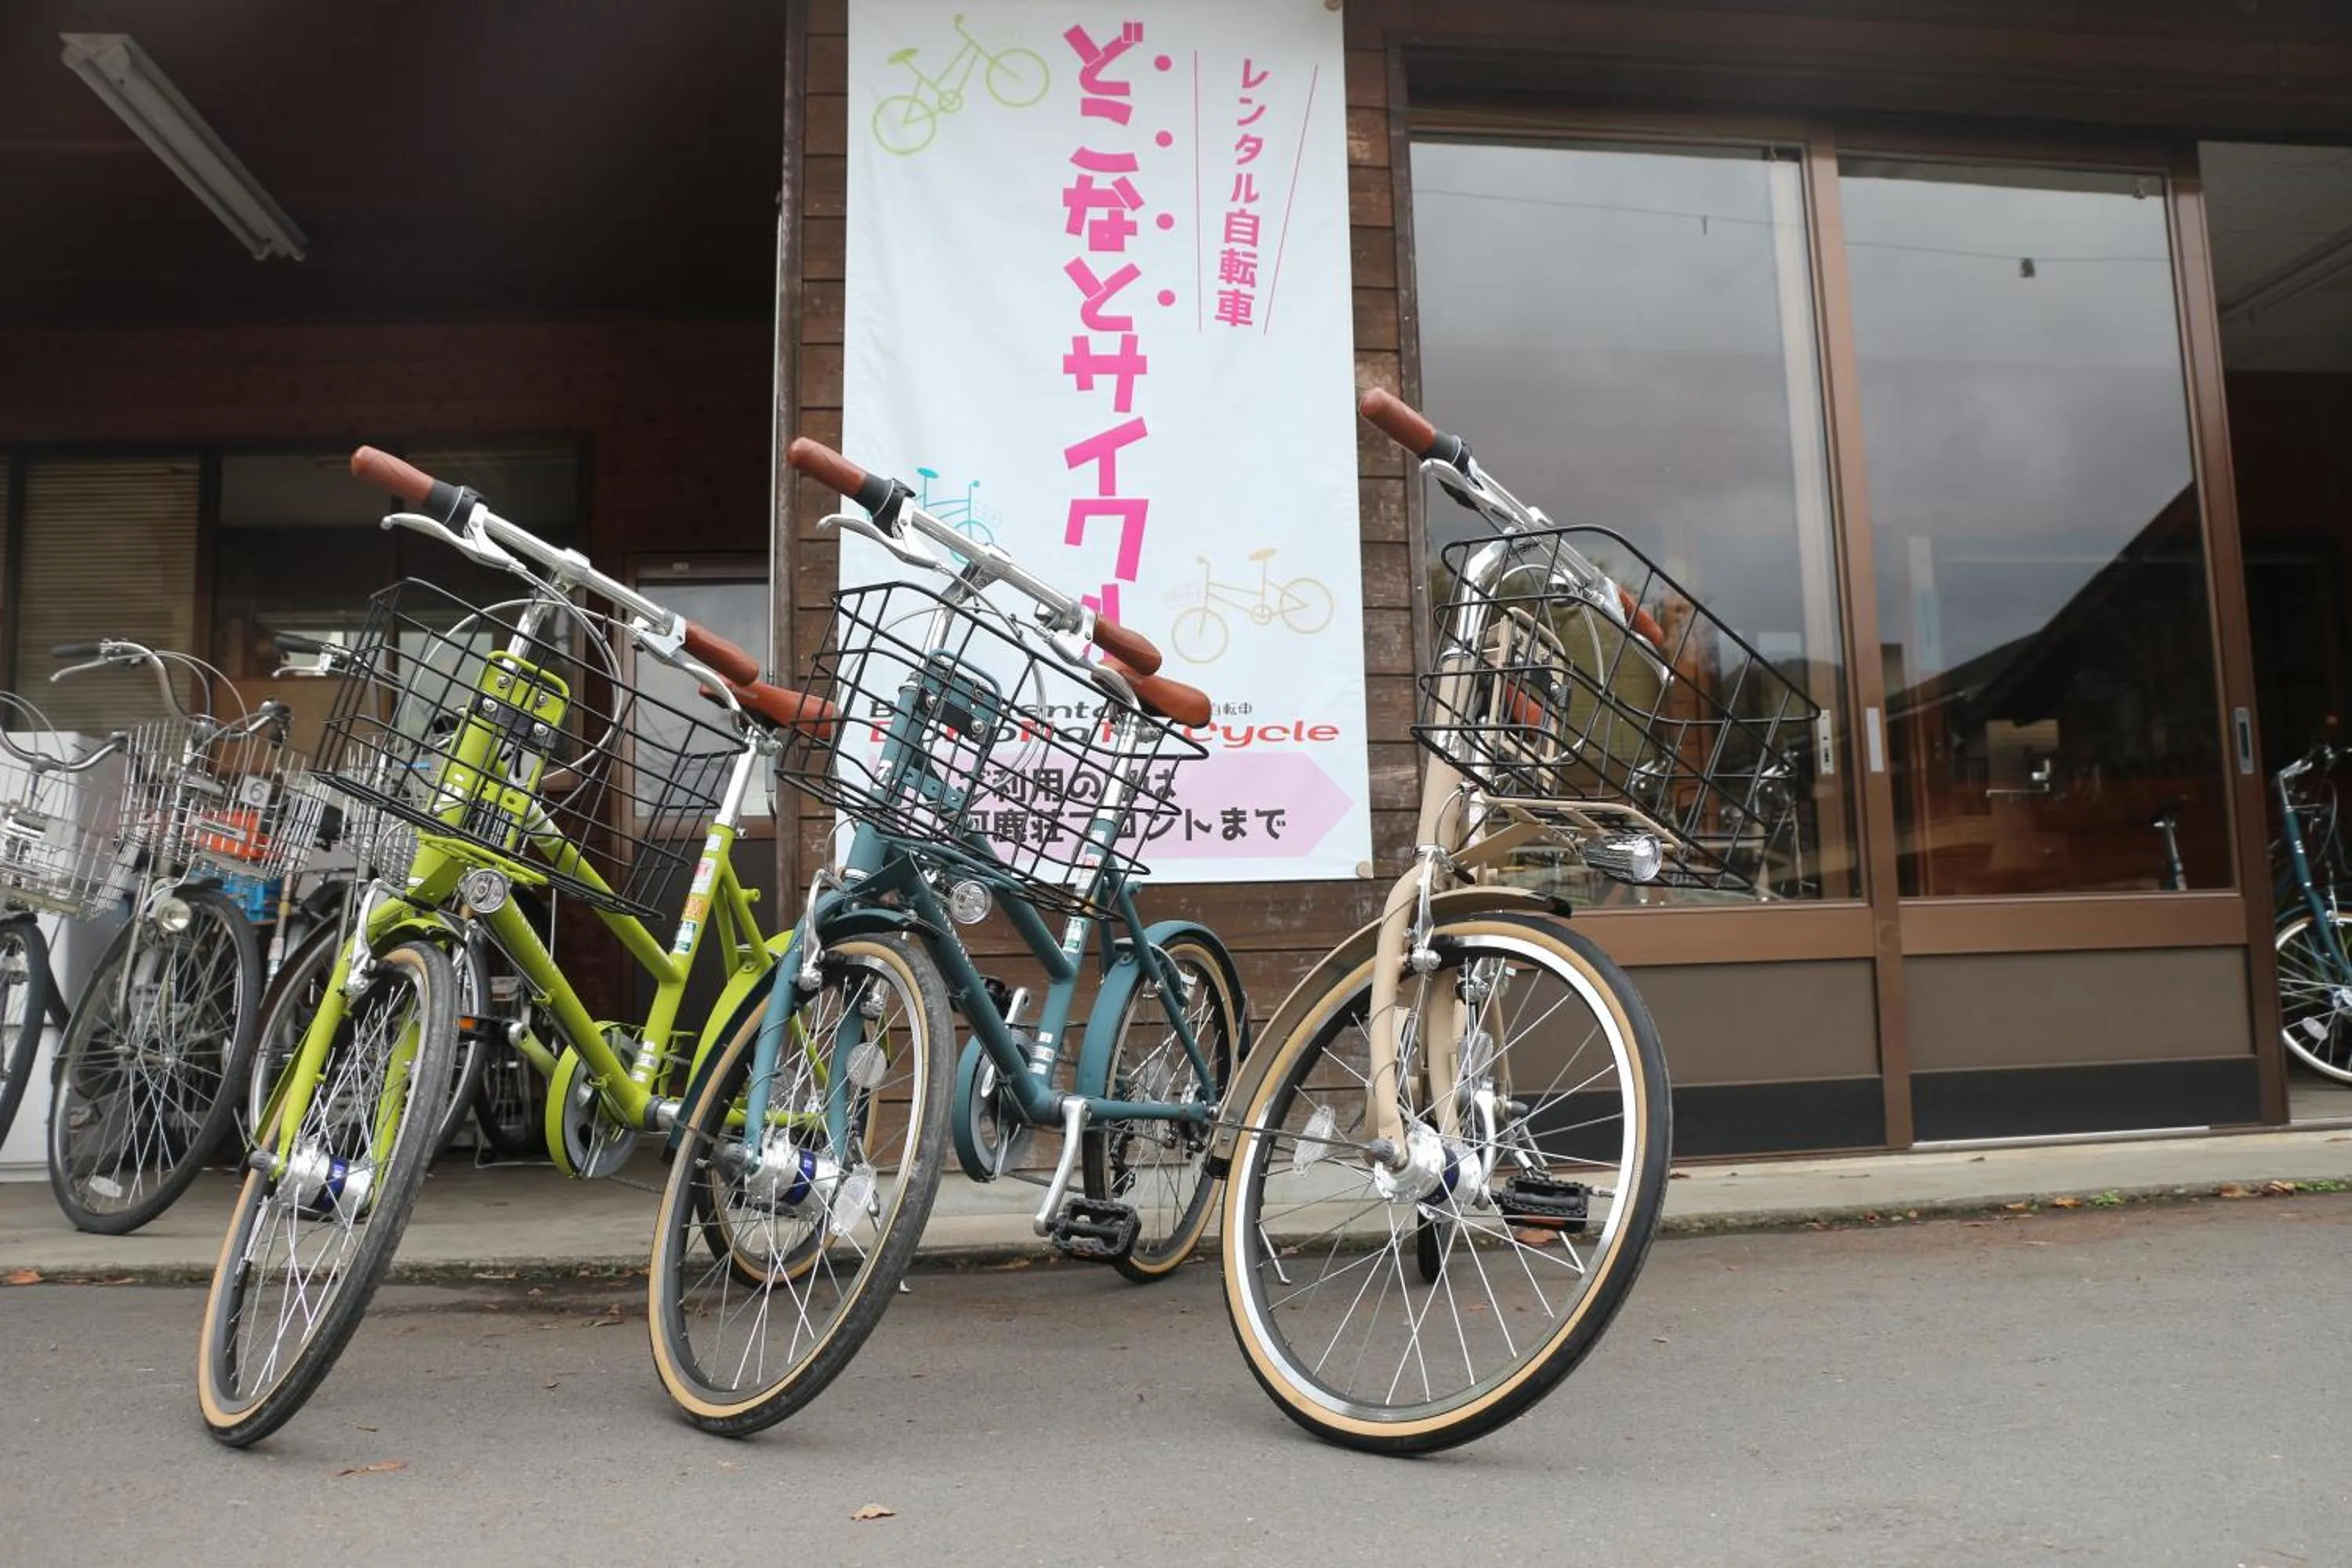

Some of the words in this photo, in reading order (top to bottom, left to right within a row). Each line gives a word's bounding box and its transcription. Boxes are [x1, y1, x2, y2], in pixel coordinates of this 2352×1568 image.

[1214, 58, 1269, 327] レンタル自転車
[1183, 720, 1340, 749] Cycle
[249, 782, 267, 802] 6
